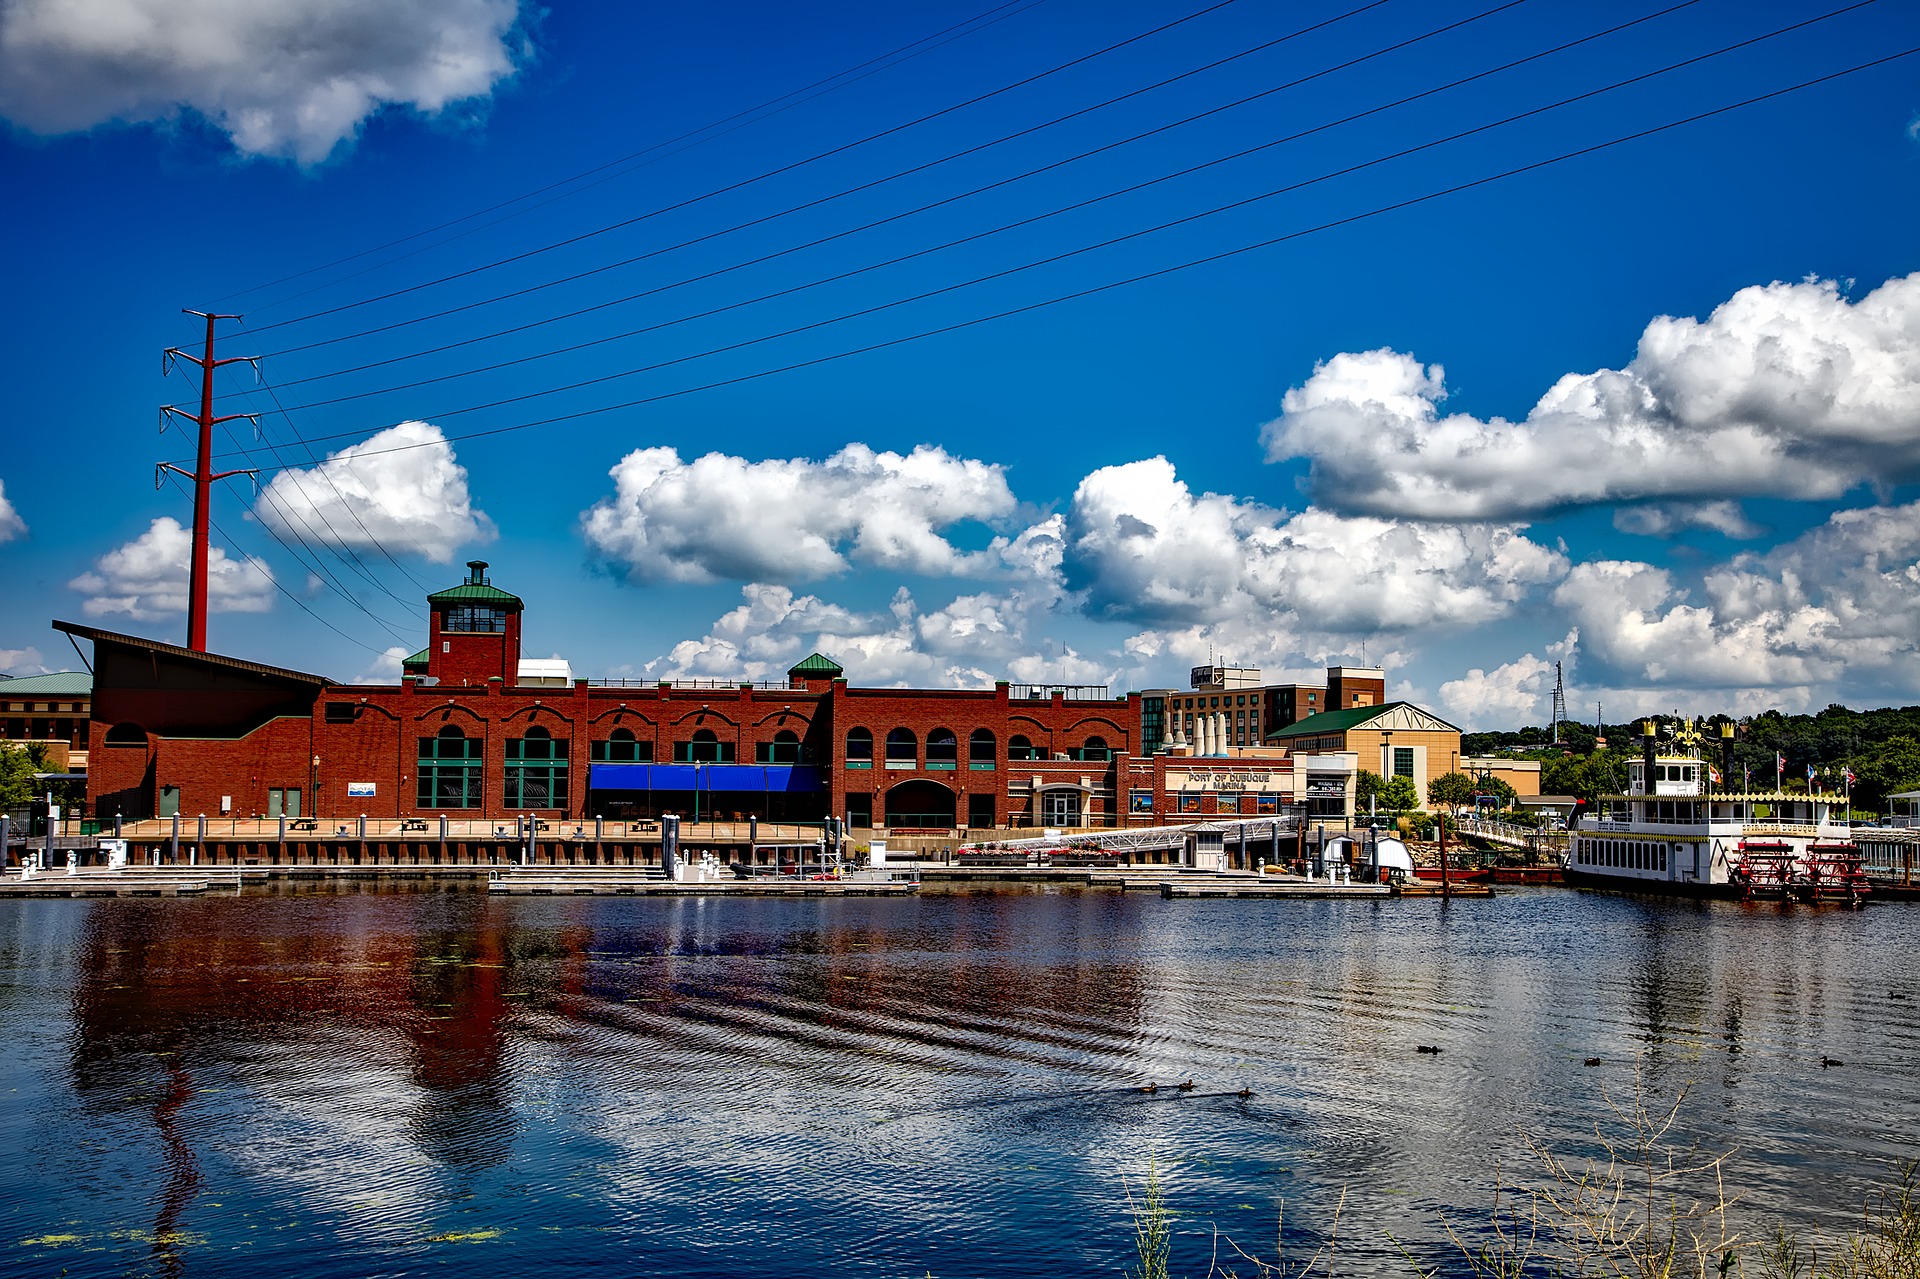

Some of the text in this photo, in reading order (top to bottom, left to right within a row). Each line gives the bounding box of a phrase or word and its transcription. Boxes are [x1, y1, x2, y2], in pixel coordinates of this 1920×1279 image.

[1188, 774, 1270, 783] PORT OF DUBUQUE
[1213, 782, 1246, 790] MARINA
[1742, 824, 1768, 832] SPIRIT
[1782, 825, 1818, 834] DUBUQUE
